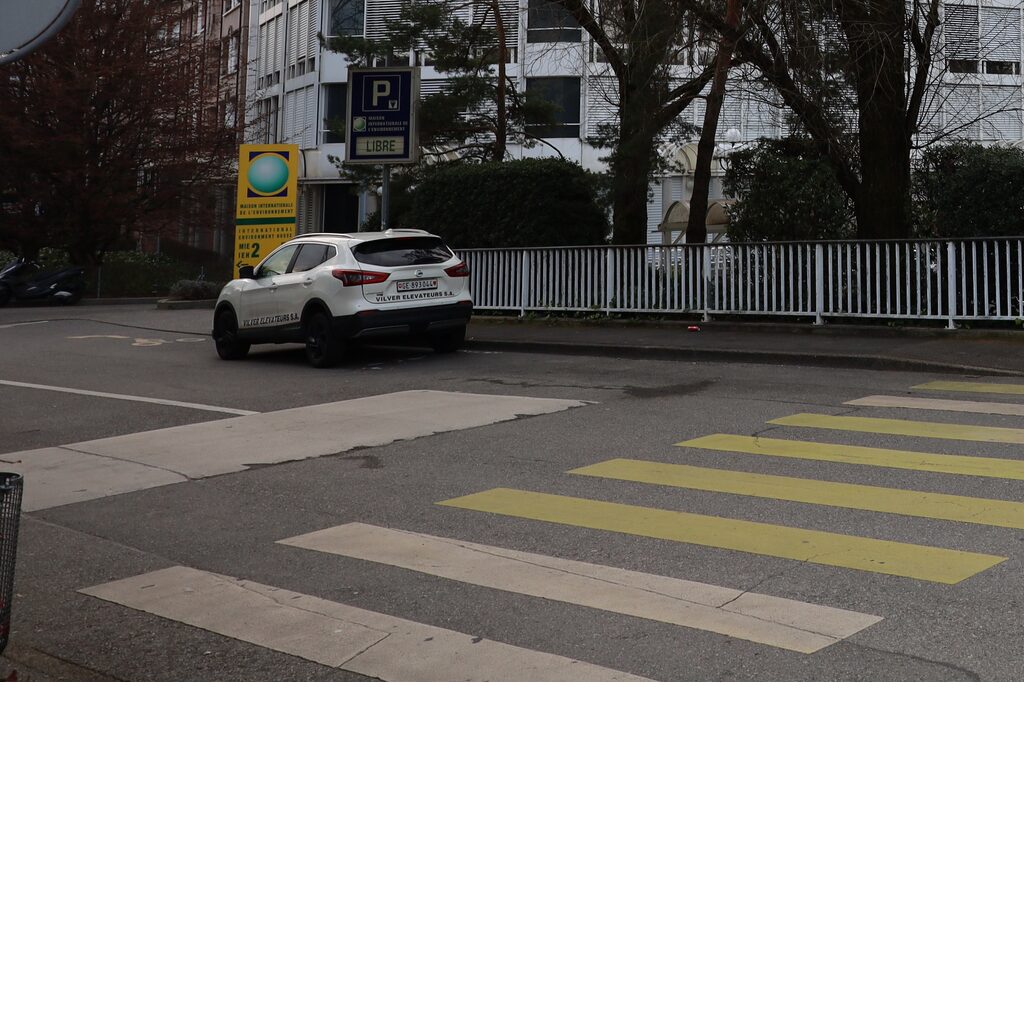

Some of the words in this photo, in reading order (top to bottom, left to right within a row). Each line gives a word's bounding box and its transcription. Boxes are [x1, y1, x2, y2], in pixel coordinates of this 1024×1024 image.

[372, 80, 391, 107] P
[366, 140, 396, 152] LIBRE
[251, 242, 260, 258] 2
[402, 292, 443, 300] ELEVATEURS
